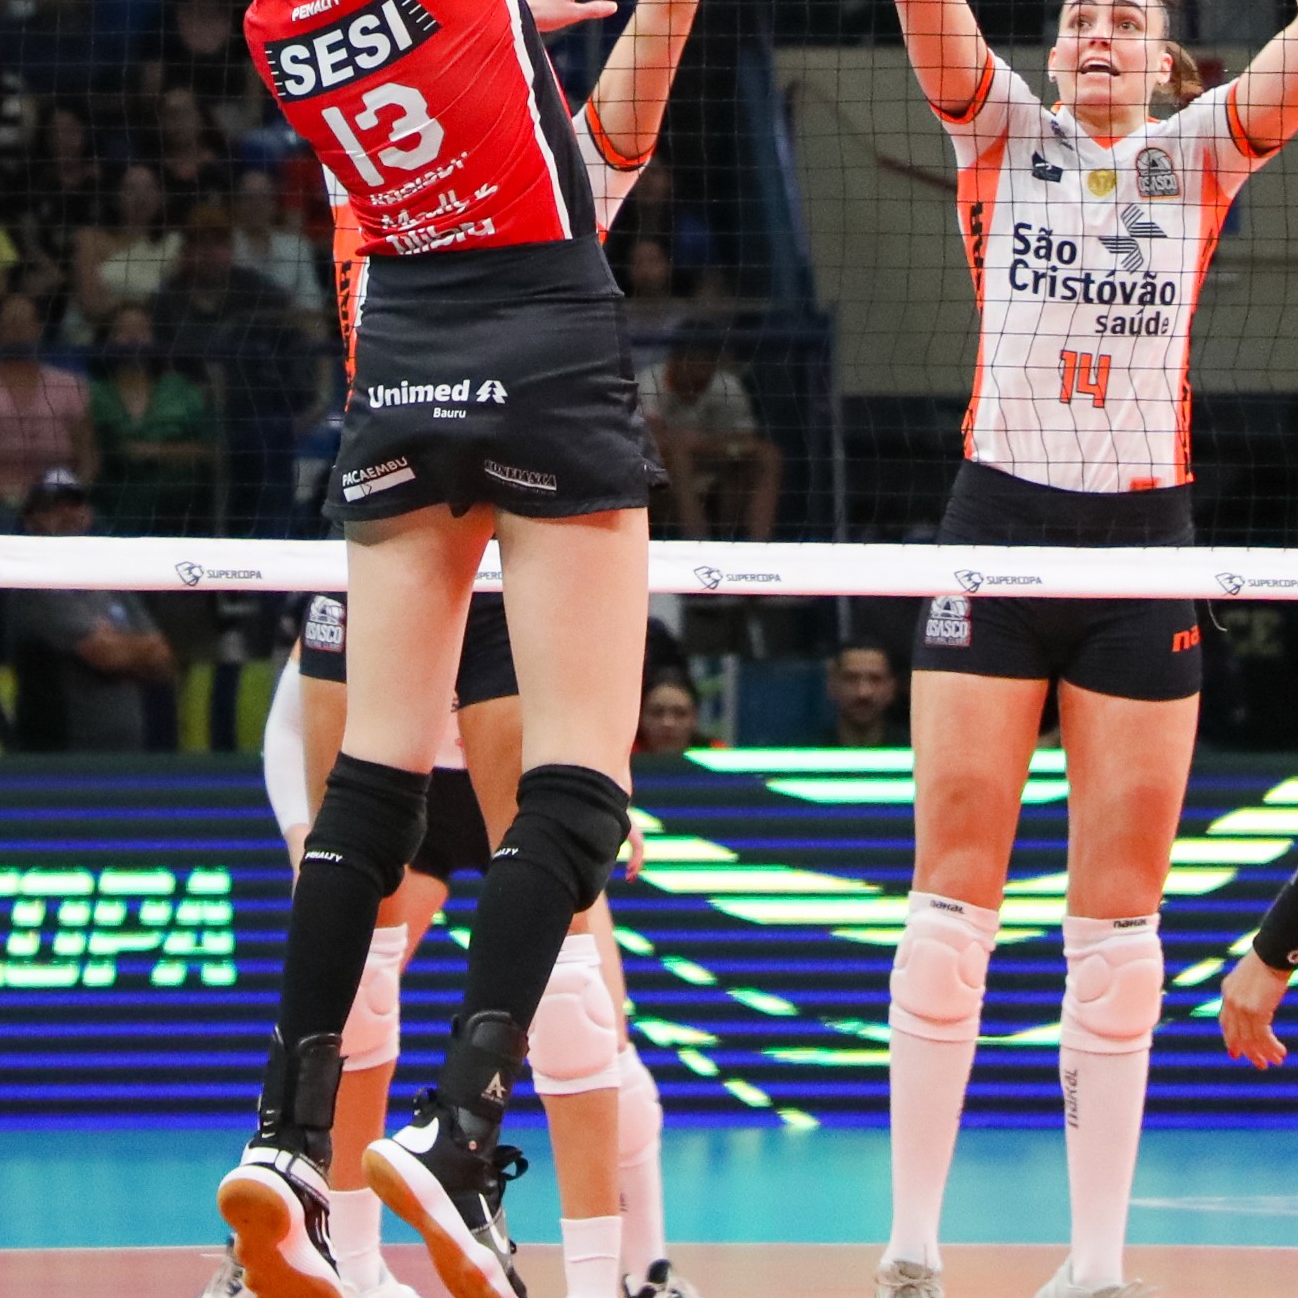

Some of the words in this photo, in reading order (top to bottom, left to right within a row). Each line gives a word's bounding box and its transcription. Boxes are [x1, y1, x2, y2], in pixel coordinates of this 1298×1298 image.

[321, 82, 445, 187] 13
[1012, 222, 1077, 265] São
[1009, 259, 1176, 306] Cristóvão
[1095, 309, 1169, 336] saúde
[368, 379, 470, 409] Unimed
[1059, 349, 1111, 409] 14
[433, 406, 466, 419] Bauru
[342, 456, 408, 487] PACAEMBU
